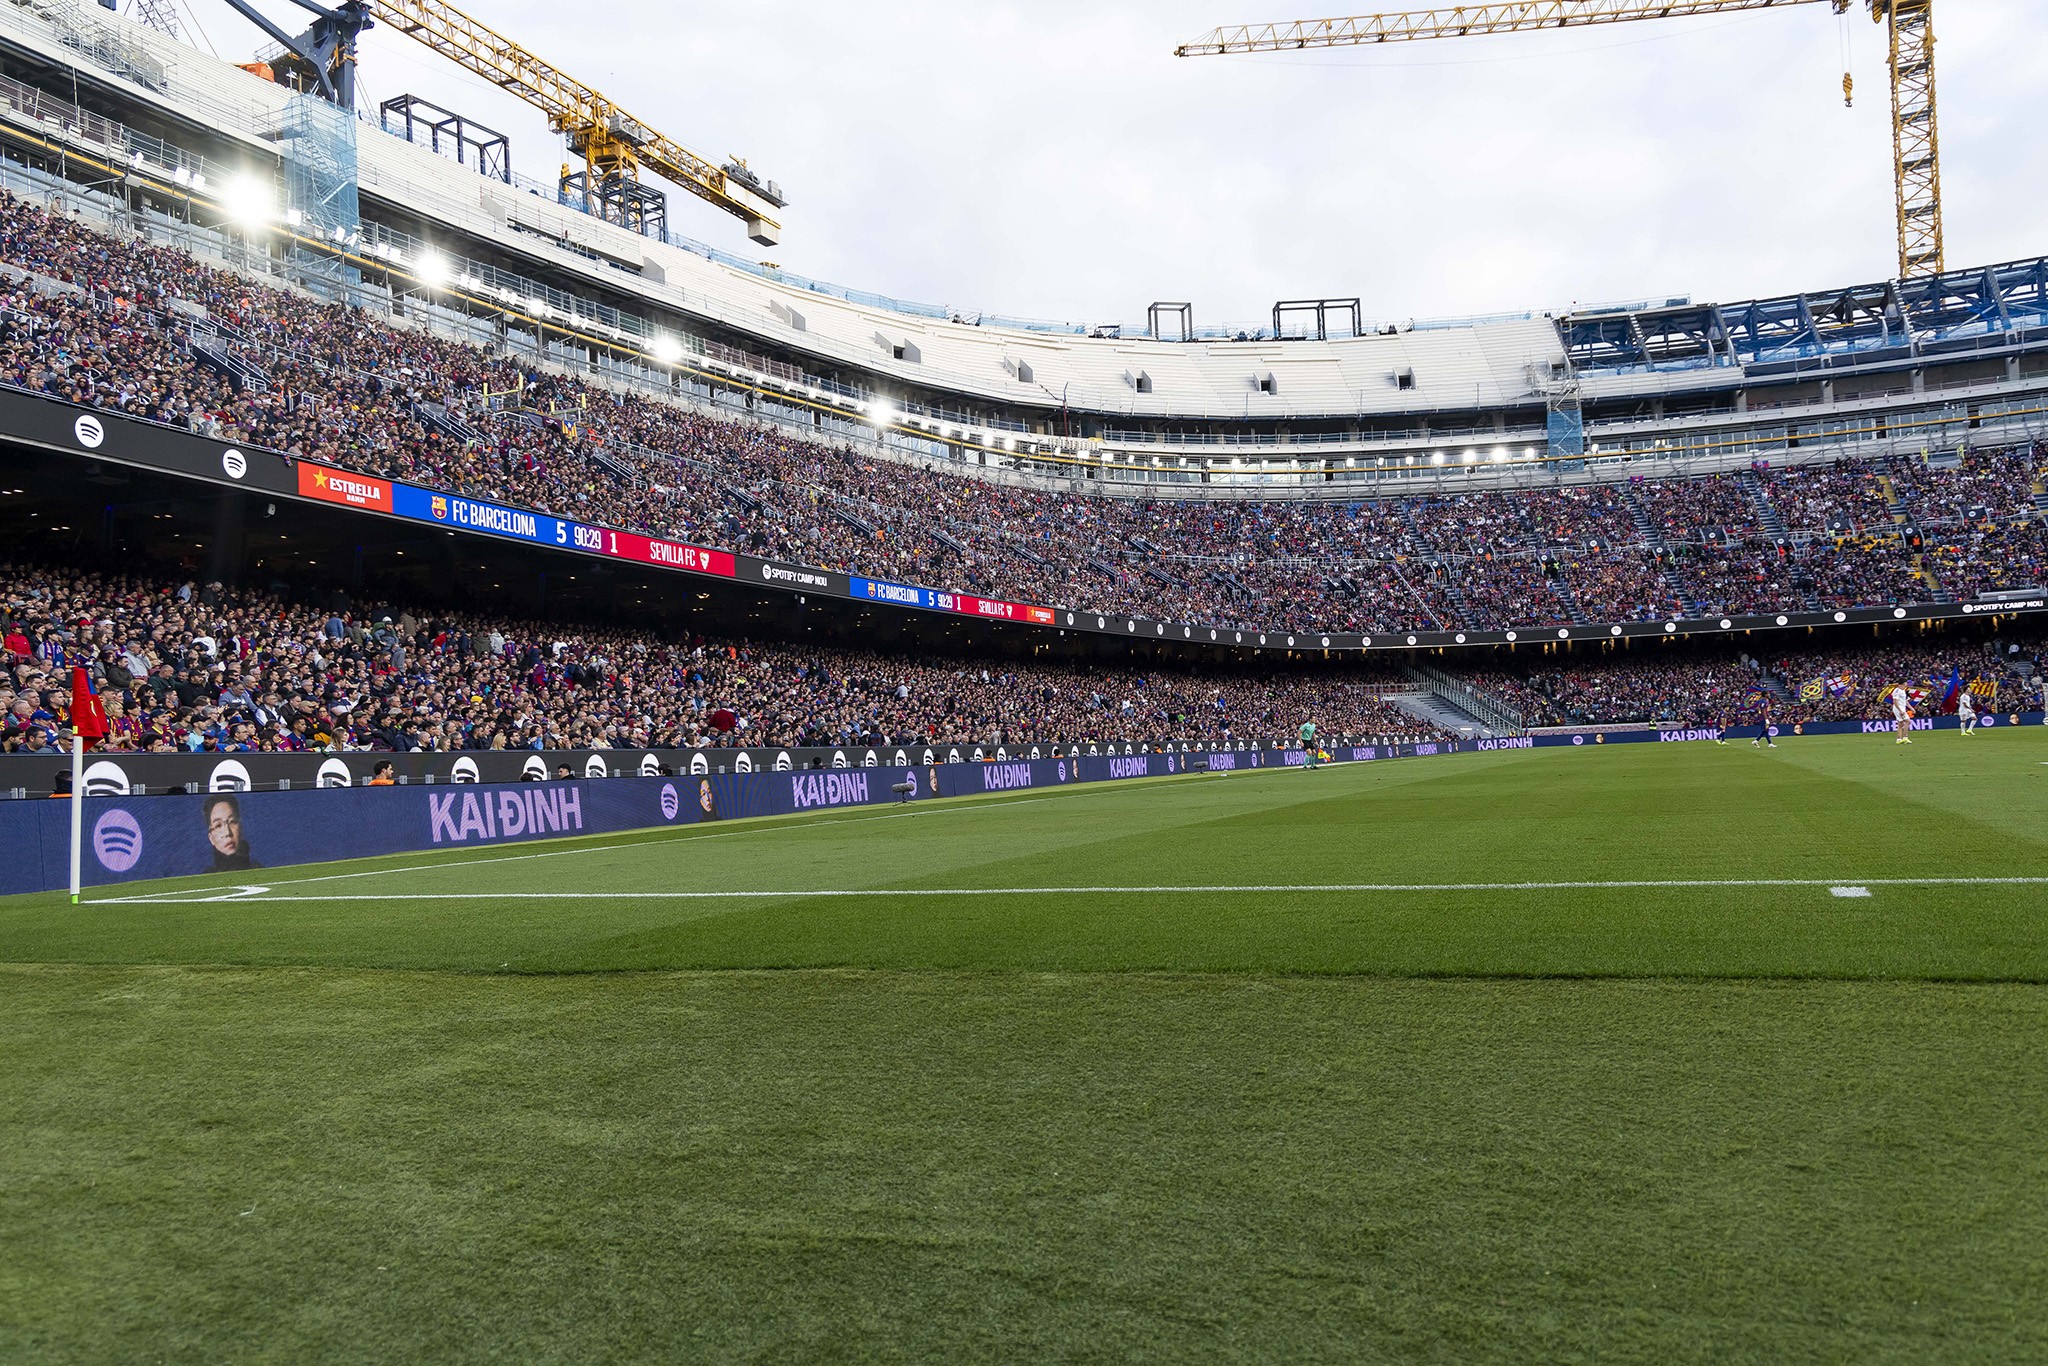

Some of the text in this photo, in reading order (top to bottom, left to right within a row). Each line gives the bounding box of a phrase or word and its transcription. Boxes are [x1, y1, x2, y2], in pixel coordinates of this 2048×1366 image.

[329, 477, 381, 500] ESTRELLA
[452, 499, 696, 567] FC BARCELONA 5 90:29 1 SEVILLA FC
[772, 568, 828, 586] SPOTIFY CAMP NOU
[877, 584, 886, 598] FC
[886, 585, 920, 604] BARCELONA
[928, 592, 934, 606] 5
[956, 596, 961, 610] 1
[978, 600, 998, 615] SEVILLA
[998, 603, 1005, 616] FC
[1974, 603, 2004, 611] SPOTIFY
[1862, 718, 1933, 732] KAI ĐNH
[1478, 740, 1498, 750] KAI
[1660, 730, 1686, 742] KAI
[984, 765, 1004, 790] KAI
[1110, 758, 1125, 778] KAI
[792, 774, 826, 808] KAI
[429, 787, 582, 842] KAI ĐINH
